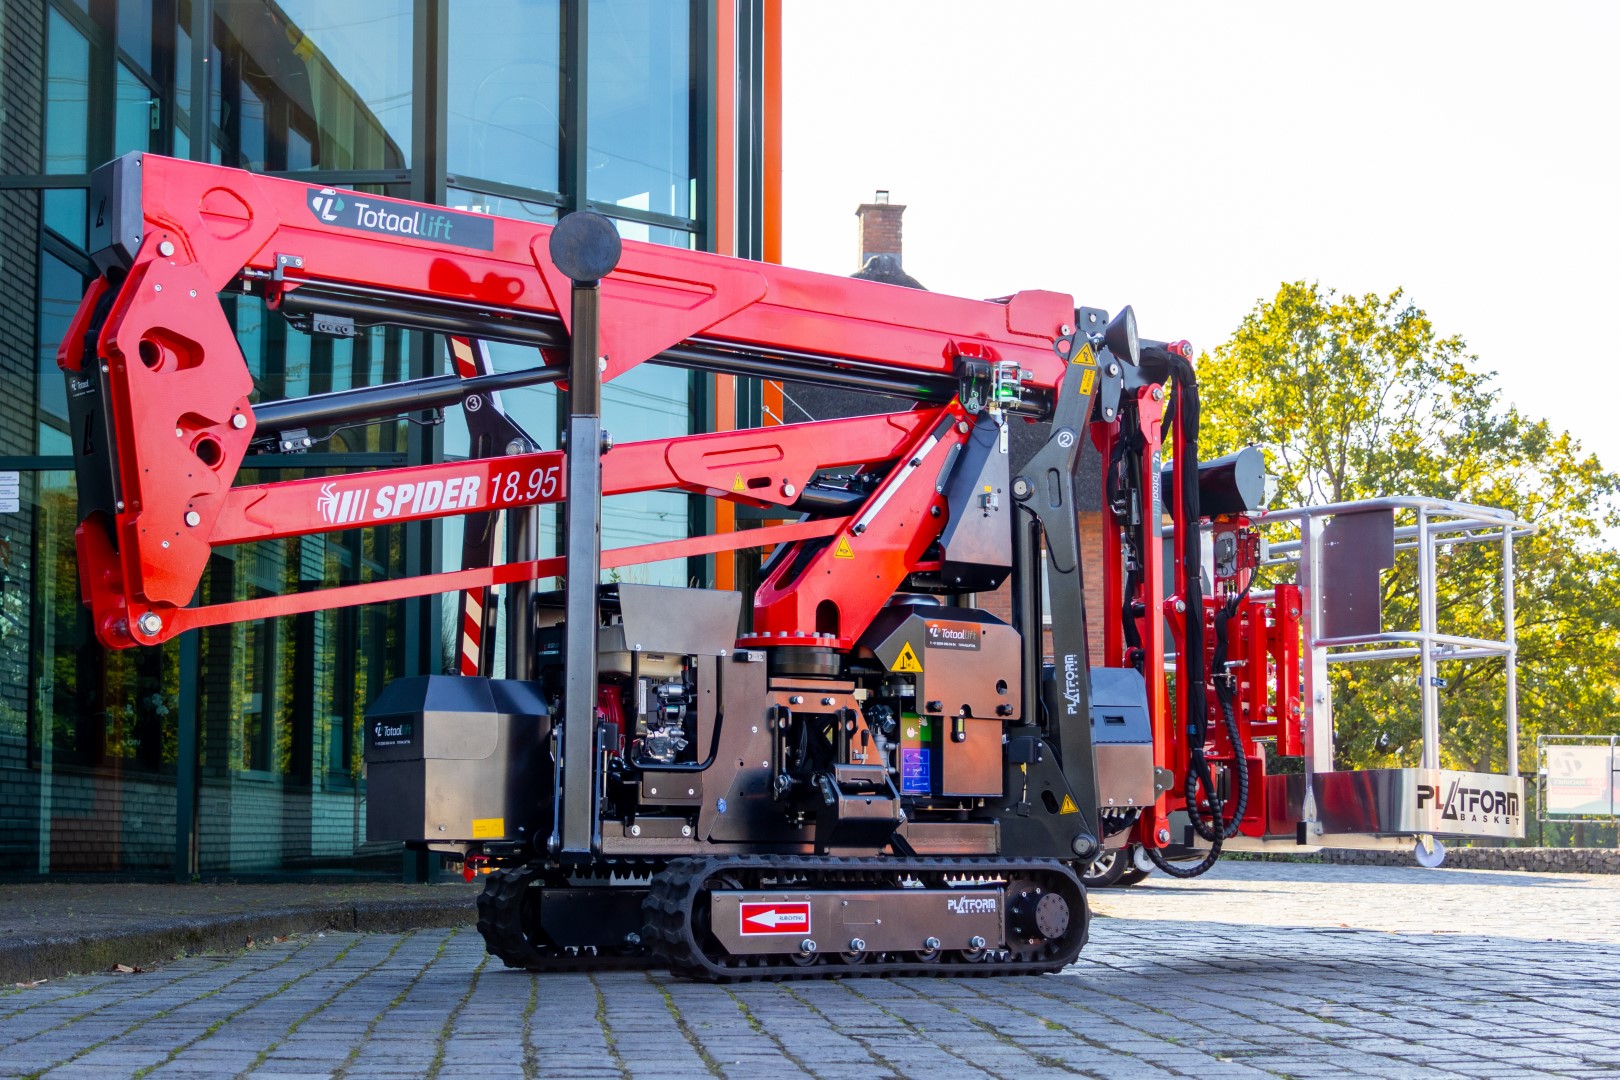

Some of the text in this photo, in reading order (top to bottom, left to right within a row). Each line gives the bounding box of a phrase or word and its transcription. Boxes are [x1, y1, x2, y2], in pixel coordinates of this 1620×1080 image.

[354, 202, 453, 240] Totaallift
[373, 466, 560, 519] SPIDER 18.95
[1063, 654, 1080, 715] PLATFORM
[1417, 777, 1519, 820] PLATFORM
[1460, 813, 1519, 826] BASKET
[947, 895, 996, 914] PLATFORM
